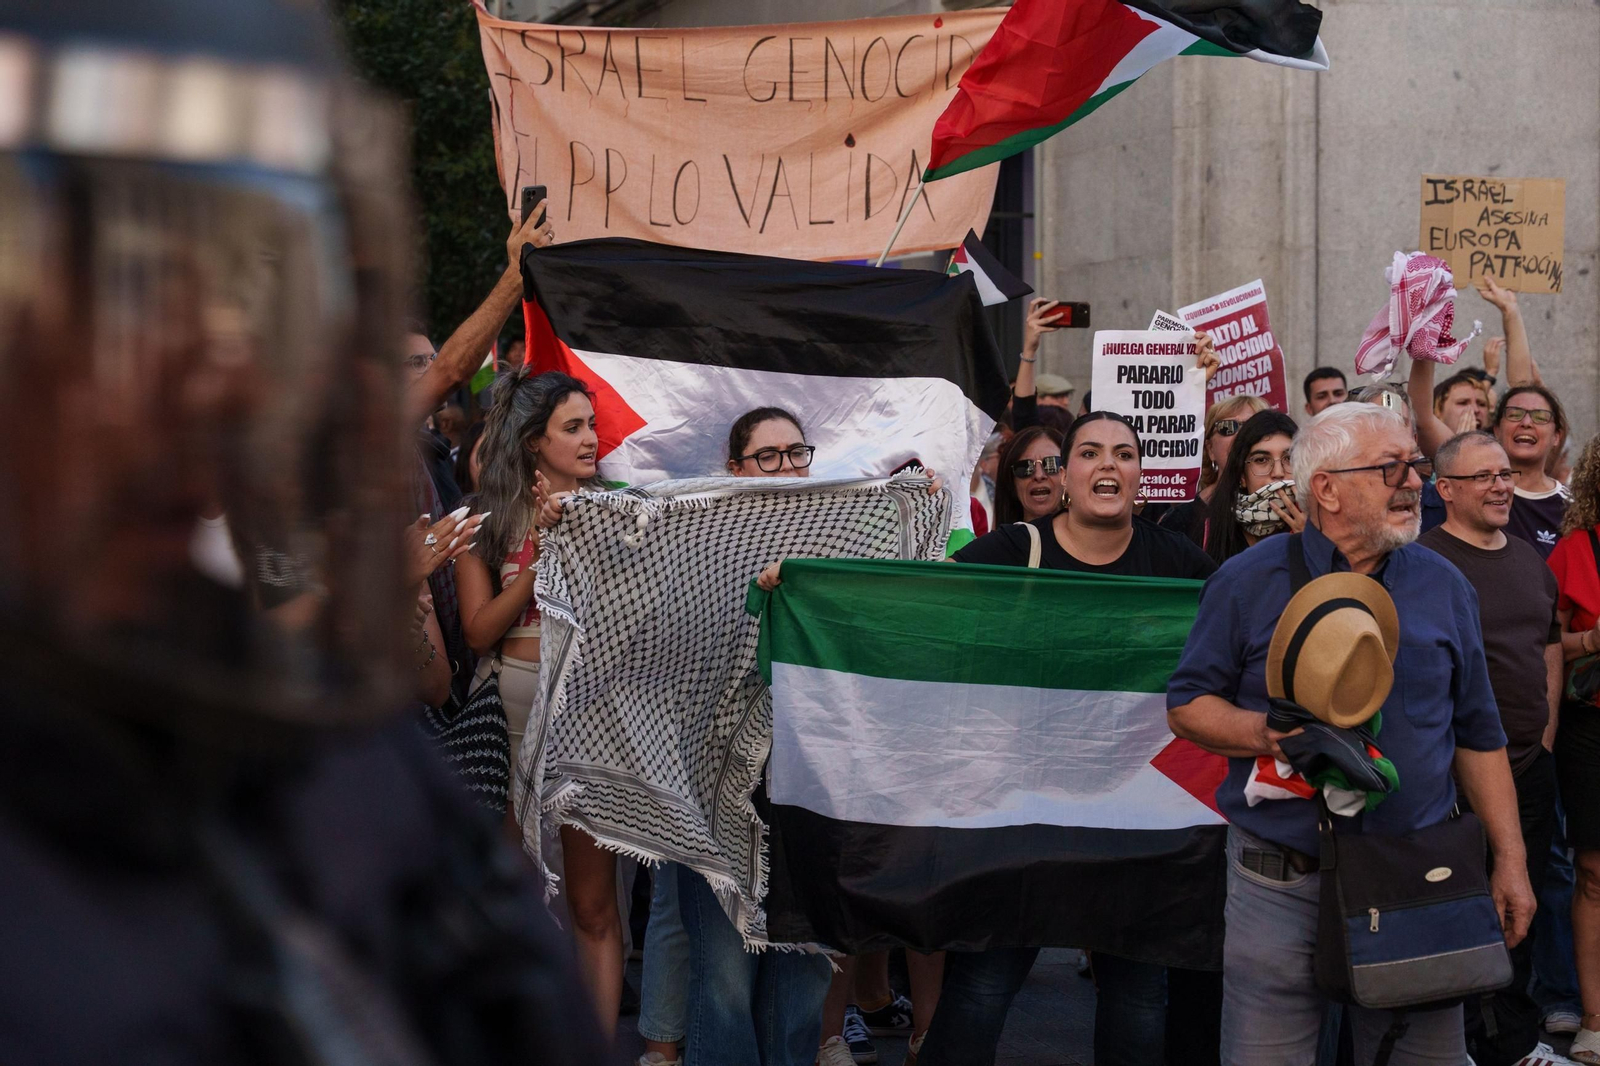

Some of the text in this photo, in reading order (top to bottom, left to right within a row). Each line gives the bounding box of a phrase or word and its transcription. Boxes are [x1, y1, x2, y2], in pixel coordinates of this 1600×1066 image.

[495, 28, 707, 102] ISRAEL
[567, 141, 628, 229] PP
[650, 153, 701, 227] LO
[1425, 178, 1514, 206] ISRAEL
[1477, 206, 1549, 227] ASESINA
[1429, 226, 1522, 251] EUROPA
[1184, 286, 1262, 321] IZQUIERDA REVOLUCIONARIA
[1154, 319, 1182, 332] GENO
[1206, 314, 1259, 346] ALTO AL
[1102, 343, 1144, 356] ¡HUELGA
[1146, 343, 1184, 355] GENERAL
[1117, 364, 1183, 384] PARARLO
[1207, 355, 1273, 390] SIONISTA
[1234, 376, 1272, 398] GAZA
[1132, 390, 1175, 409] TODO
[1147, 414, 1196, 434] PARAR
[1171, 473, 1187, 485] de
